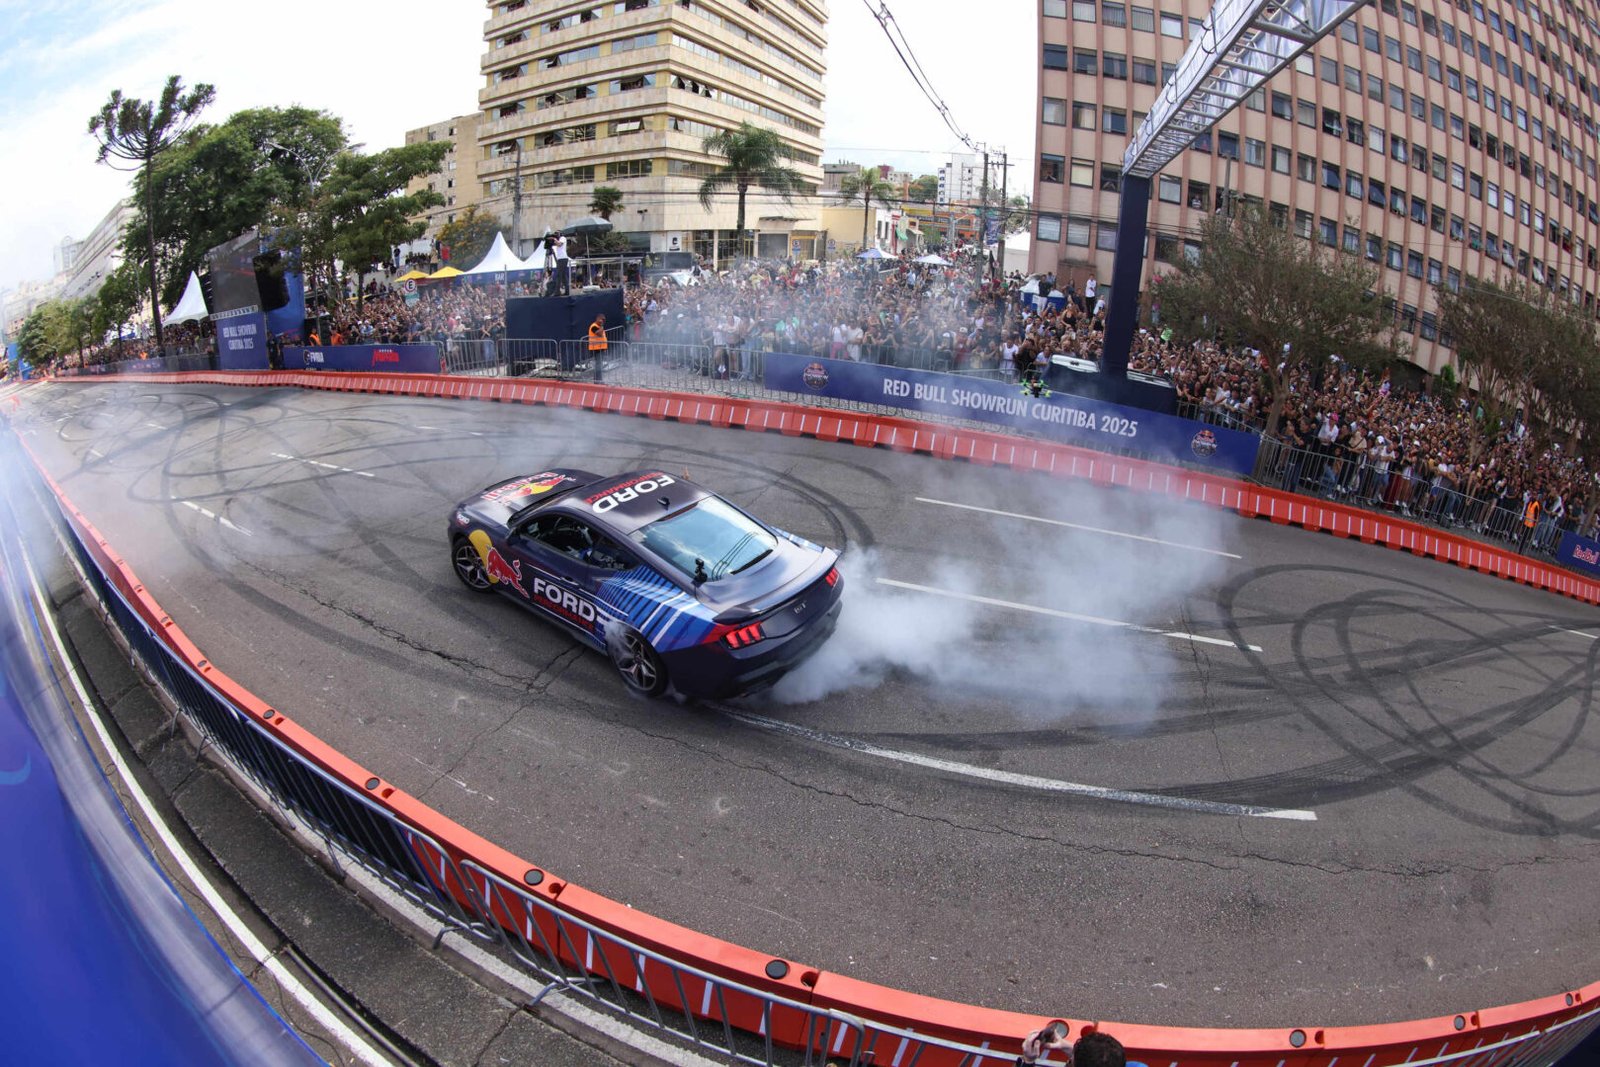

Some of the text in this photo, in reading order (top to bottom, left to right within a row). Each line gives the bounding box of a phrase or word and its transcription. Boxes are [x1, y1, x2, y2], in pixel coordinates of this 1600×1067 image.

[494, 272, 505, 281] BAR
[883, 378, 1138, 437] RED BULL SHOWRUN CURITIBA 2025
[592, 474, 676, 514] FORD
[533, 577, 596, 623] FORD
